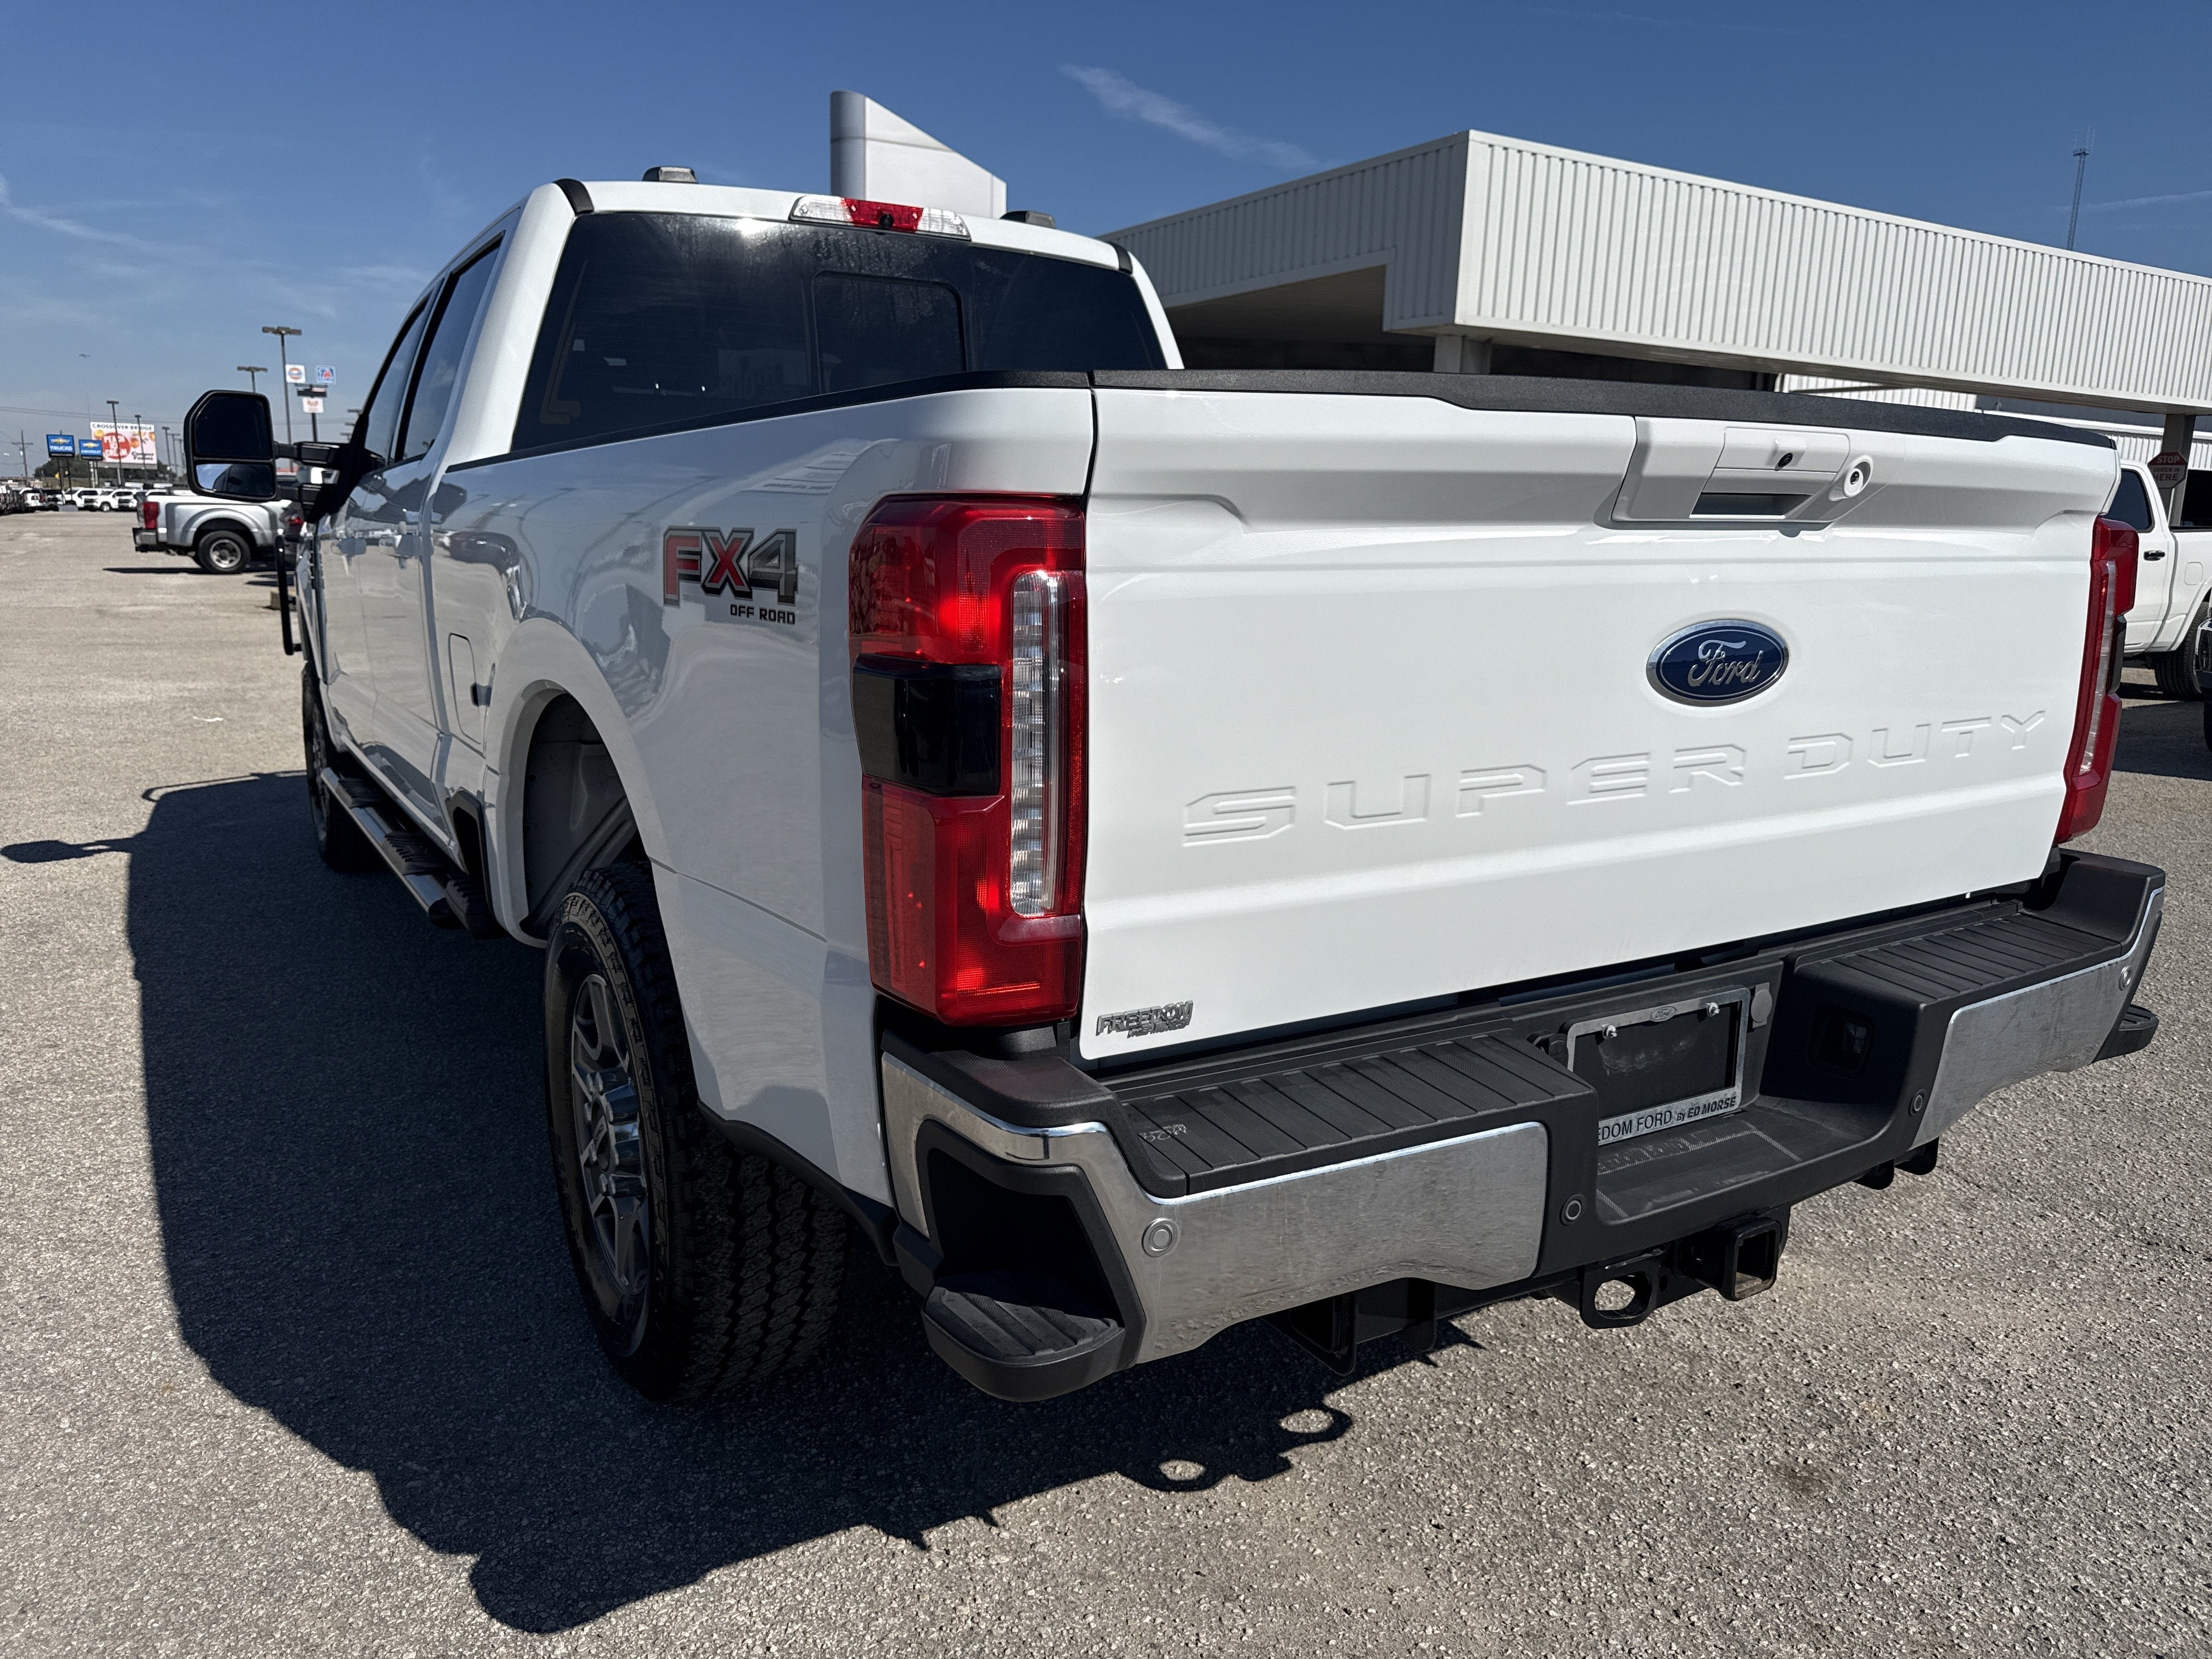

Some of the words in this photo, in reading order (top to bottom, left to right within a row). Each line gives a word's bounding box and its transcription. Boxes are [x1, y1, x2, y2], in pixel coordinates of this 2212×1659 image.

[2153, 473, 2179, 481] HERE
[2157, 455, 2180, 464] STOP
[663, 526, 799, 608] FX4
[730, 603, 755, 618] OFF
[759, 607, 795, 625] ROAD
[1687, 639, 1764, 687] Ford
[1182, 743, 1747, 848] SUPER
[1784, 710, 2046, 780] DUTY
[1096, 1000, 1194, 1036] FREEDOM
[1637, 1110, 1672, 1132] FORD
[1687, 1105, 1701, 1119] ED
[1701, 1096, 1736, 1116] MORSE
